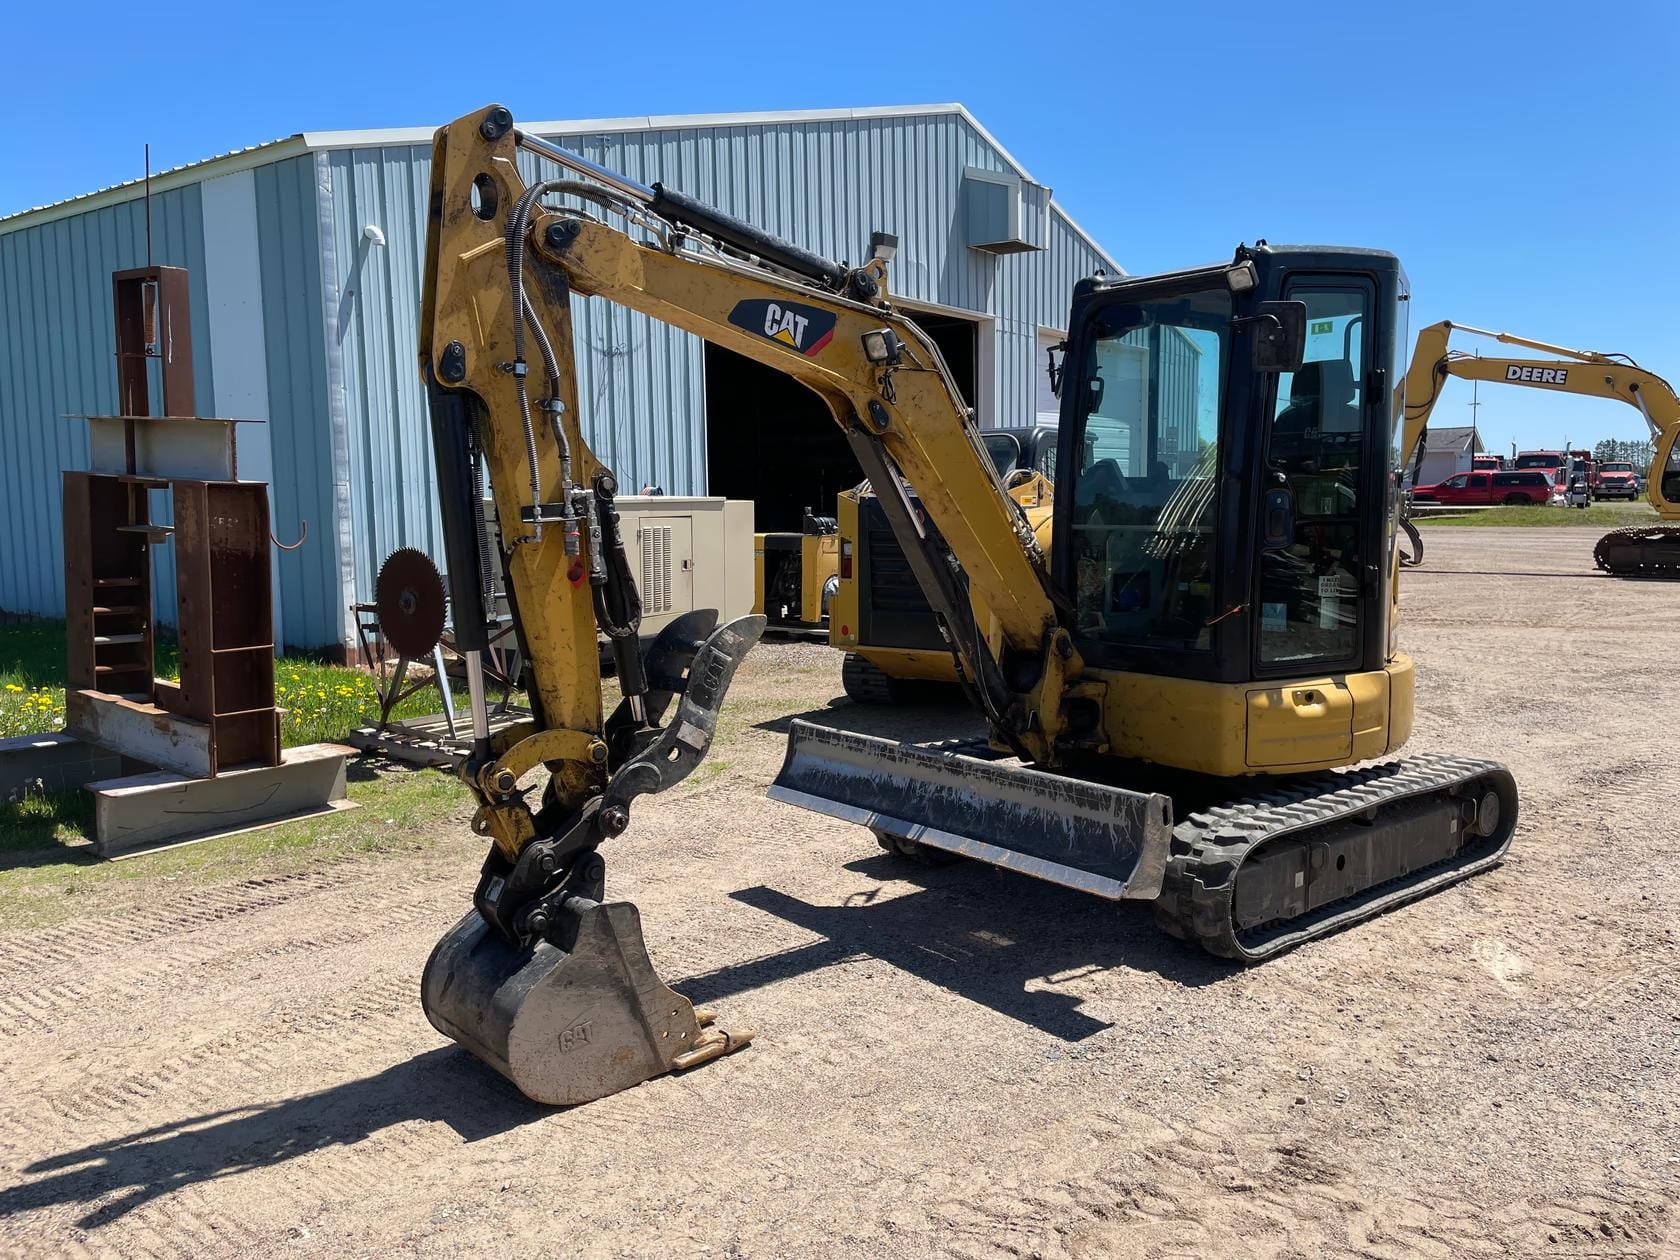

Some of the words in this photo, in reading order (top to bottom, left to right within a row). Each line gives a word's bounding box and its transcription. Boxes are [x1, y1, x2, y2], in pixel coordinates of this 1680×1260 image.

[764, 303, 809, 349] CAT
[1506, 366, 1567, 384] DEERE
[559, 1020, 594, 1055] CAT
